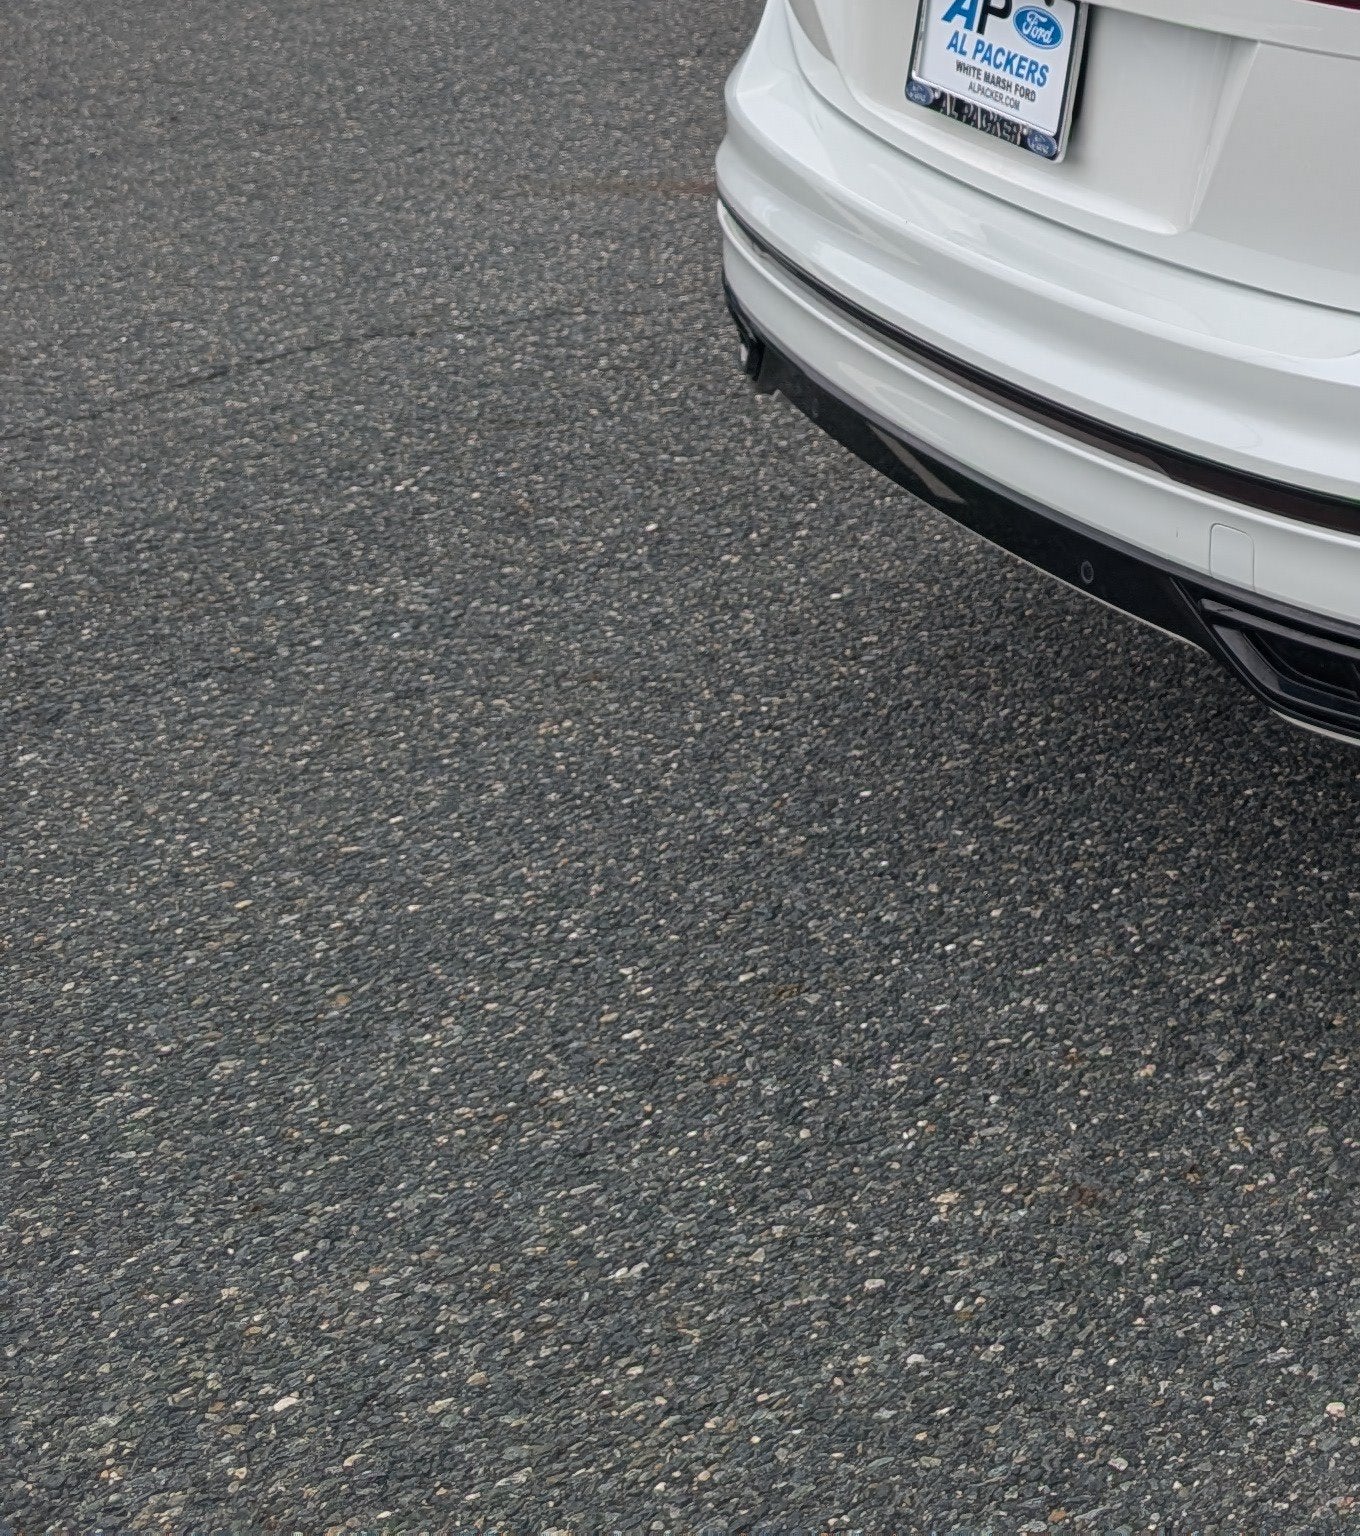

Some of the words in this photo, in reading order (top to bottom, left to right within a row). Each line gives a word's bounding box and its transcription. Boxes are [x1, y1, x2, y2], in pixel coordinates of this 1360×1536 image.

[1022, 11, 1055, 44] Ford
[946, 30, 967, 56] AL
[972, 39, 1049, 87] PACKERS
[956, 60, 982, 81] WHITE
[984, 71, 1012, 92] MARSH
[1014, 84, 1036, 102] FORD
